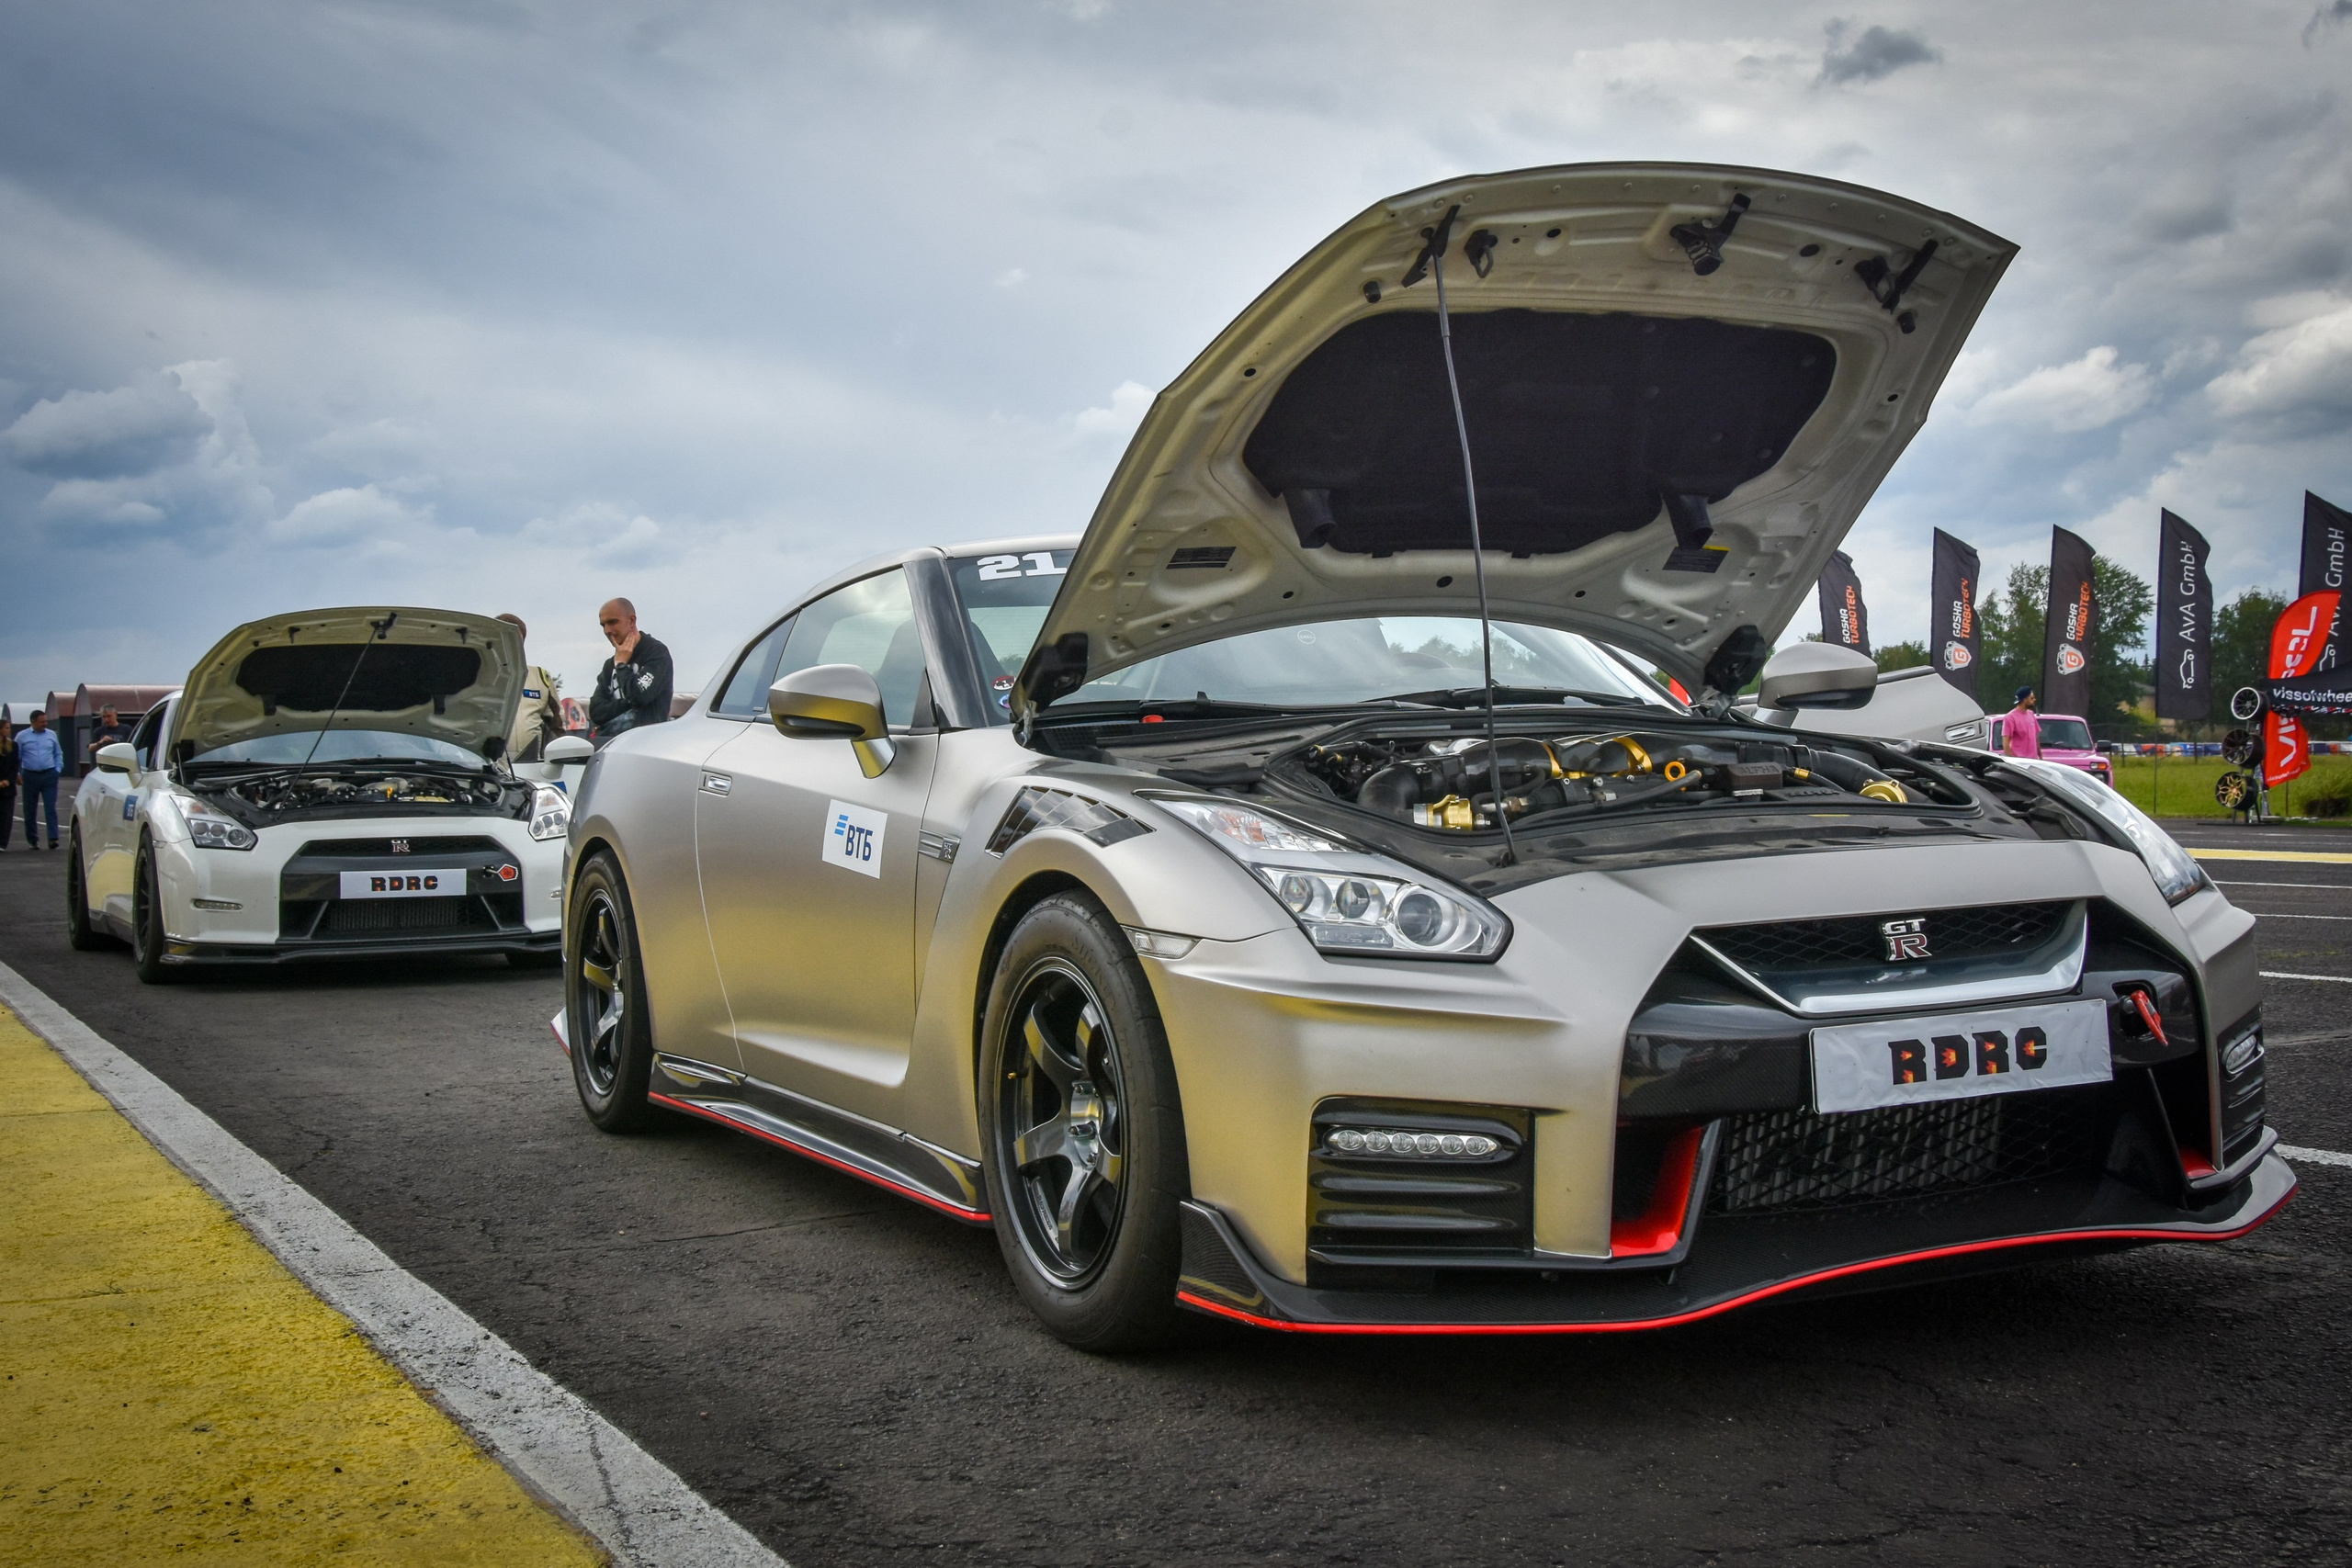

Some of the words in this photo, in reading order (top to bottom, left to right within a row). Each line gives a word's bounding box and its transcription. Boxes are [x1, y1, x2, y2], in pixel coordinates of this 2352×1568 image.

[977, 552, 1068, 581] 21
[2324, 527, 2345, 587] GmbH
[1839, 608, 1850, 644] GOSHA
[1952, 600, 1962, 637] GOSHA
[2066, 603, 2078, 640] GOSHA
[845, 824, 874, 862] ВТБ
[370, 875, 438, 892] RDRC
[1888, 1025, 2048, 1086] RDRC
